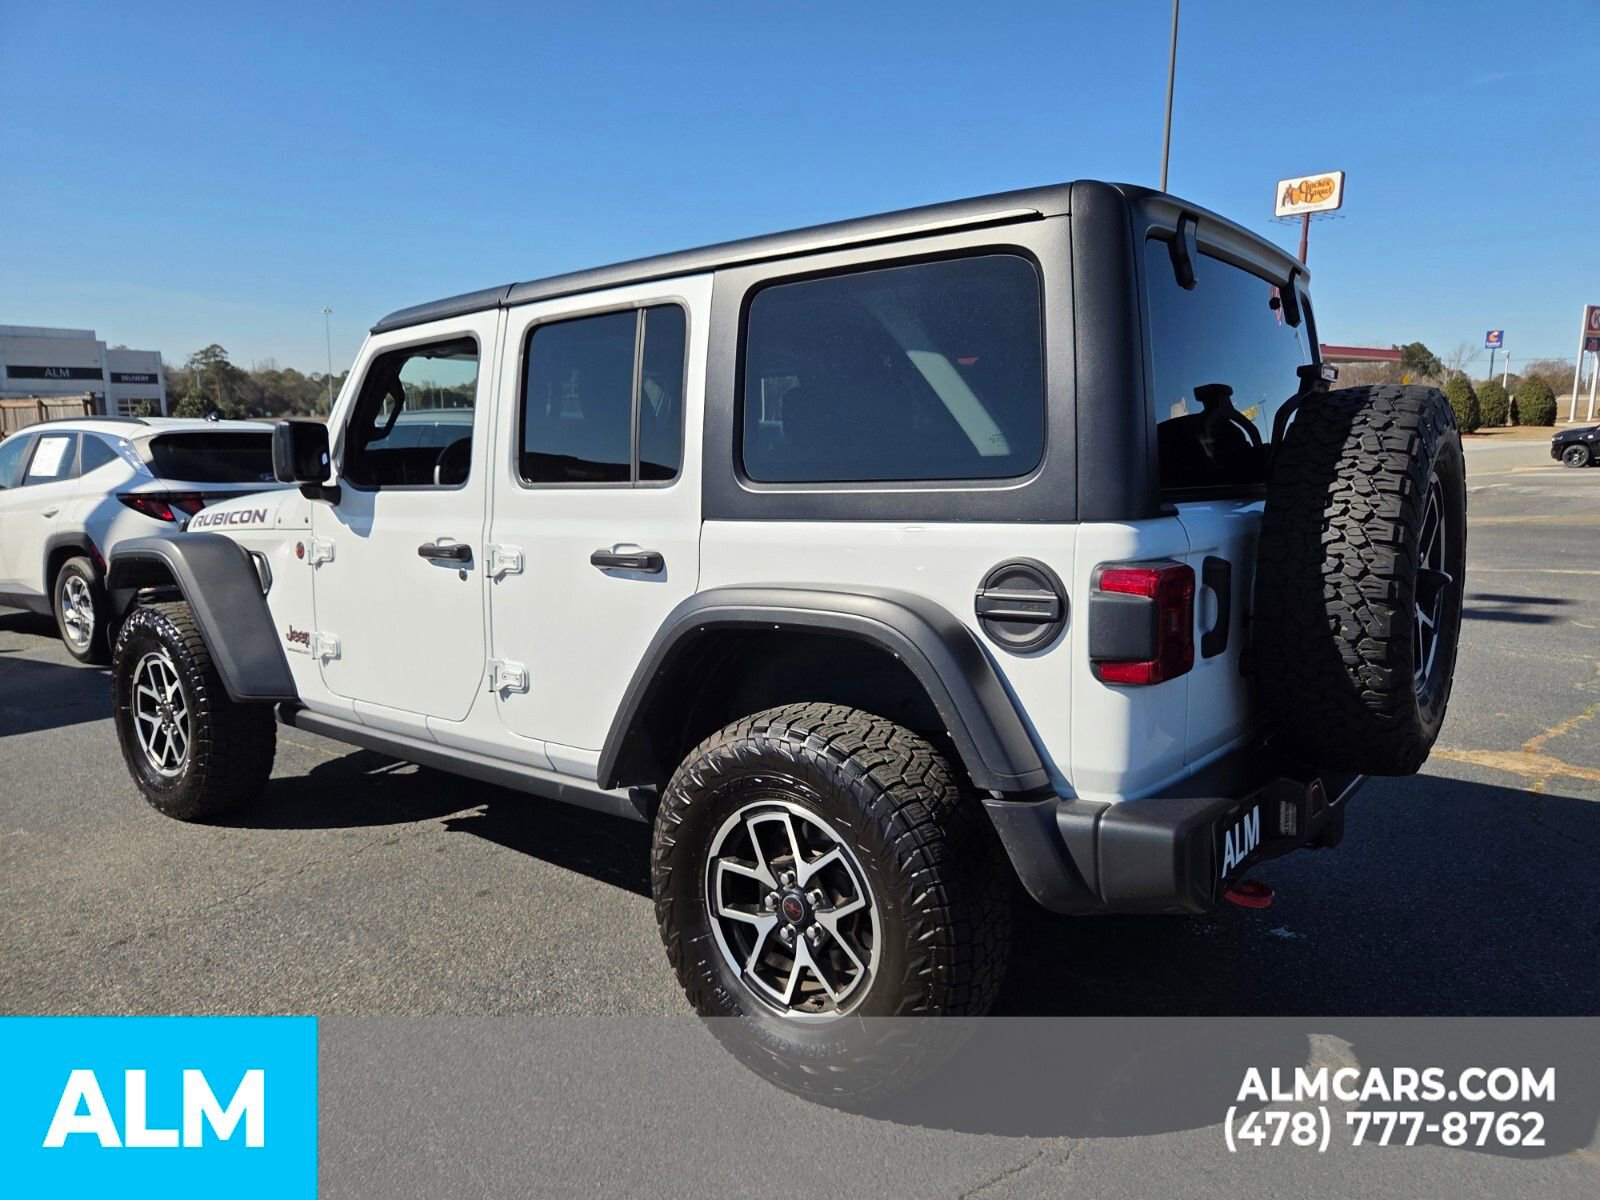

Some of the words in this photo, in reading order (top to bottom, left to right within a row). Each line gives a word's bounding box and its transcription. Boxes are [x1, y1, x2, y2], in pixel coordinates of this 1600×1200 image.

[44, 367, 71, 378] ALM
[193, 508, 268, 528] RUBICON
[286, 624, 310, 648] Jeep
[1221, 804, 1260, 879] ALM
